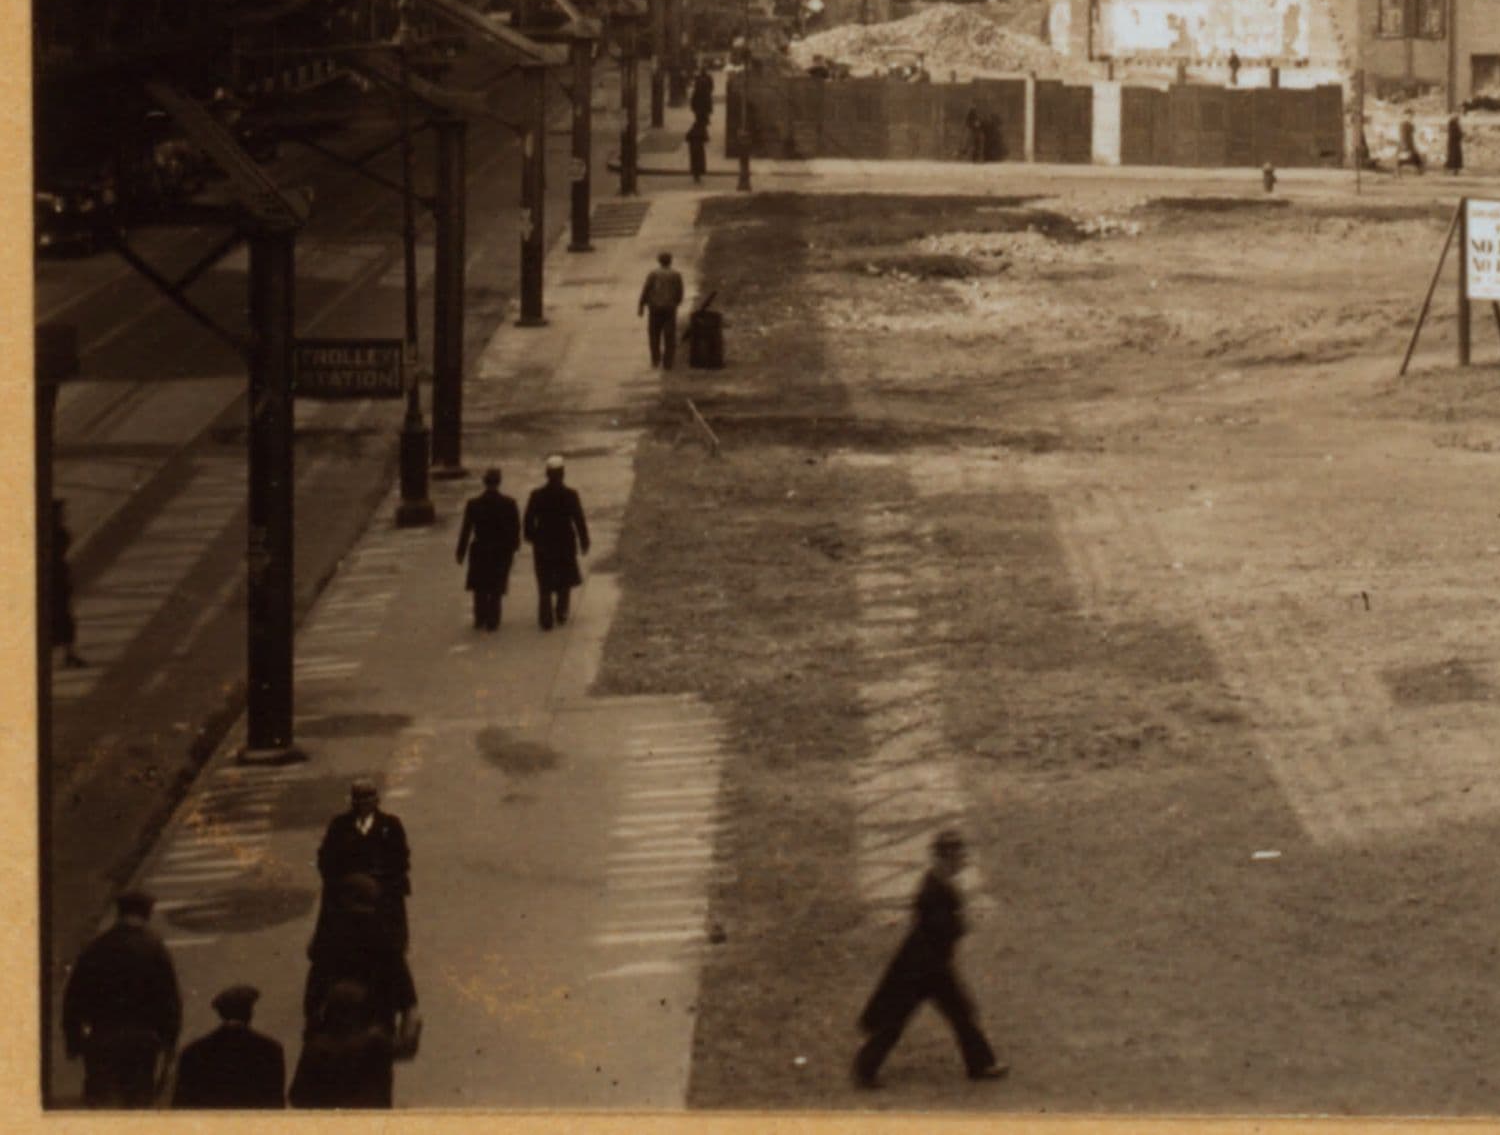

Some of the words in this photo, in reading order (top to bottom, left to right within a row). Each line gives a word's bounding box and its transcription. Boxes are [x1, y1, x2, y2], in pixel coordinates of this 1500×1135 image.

[1471, 238, 1493, 254] NO
[1471, 256, 1492, 272] NO
[302, 347, 393, 365] TROLLEY
[302, 368, 396, 387] STATION
